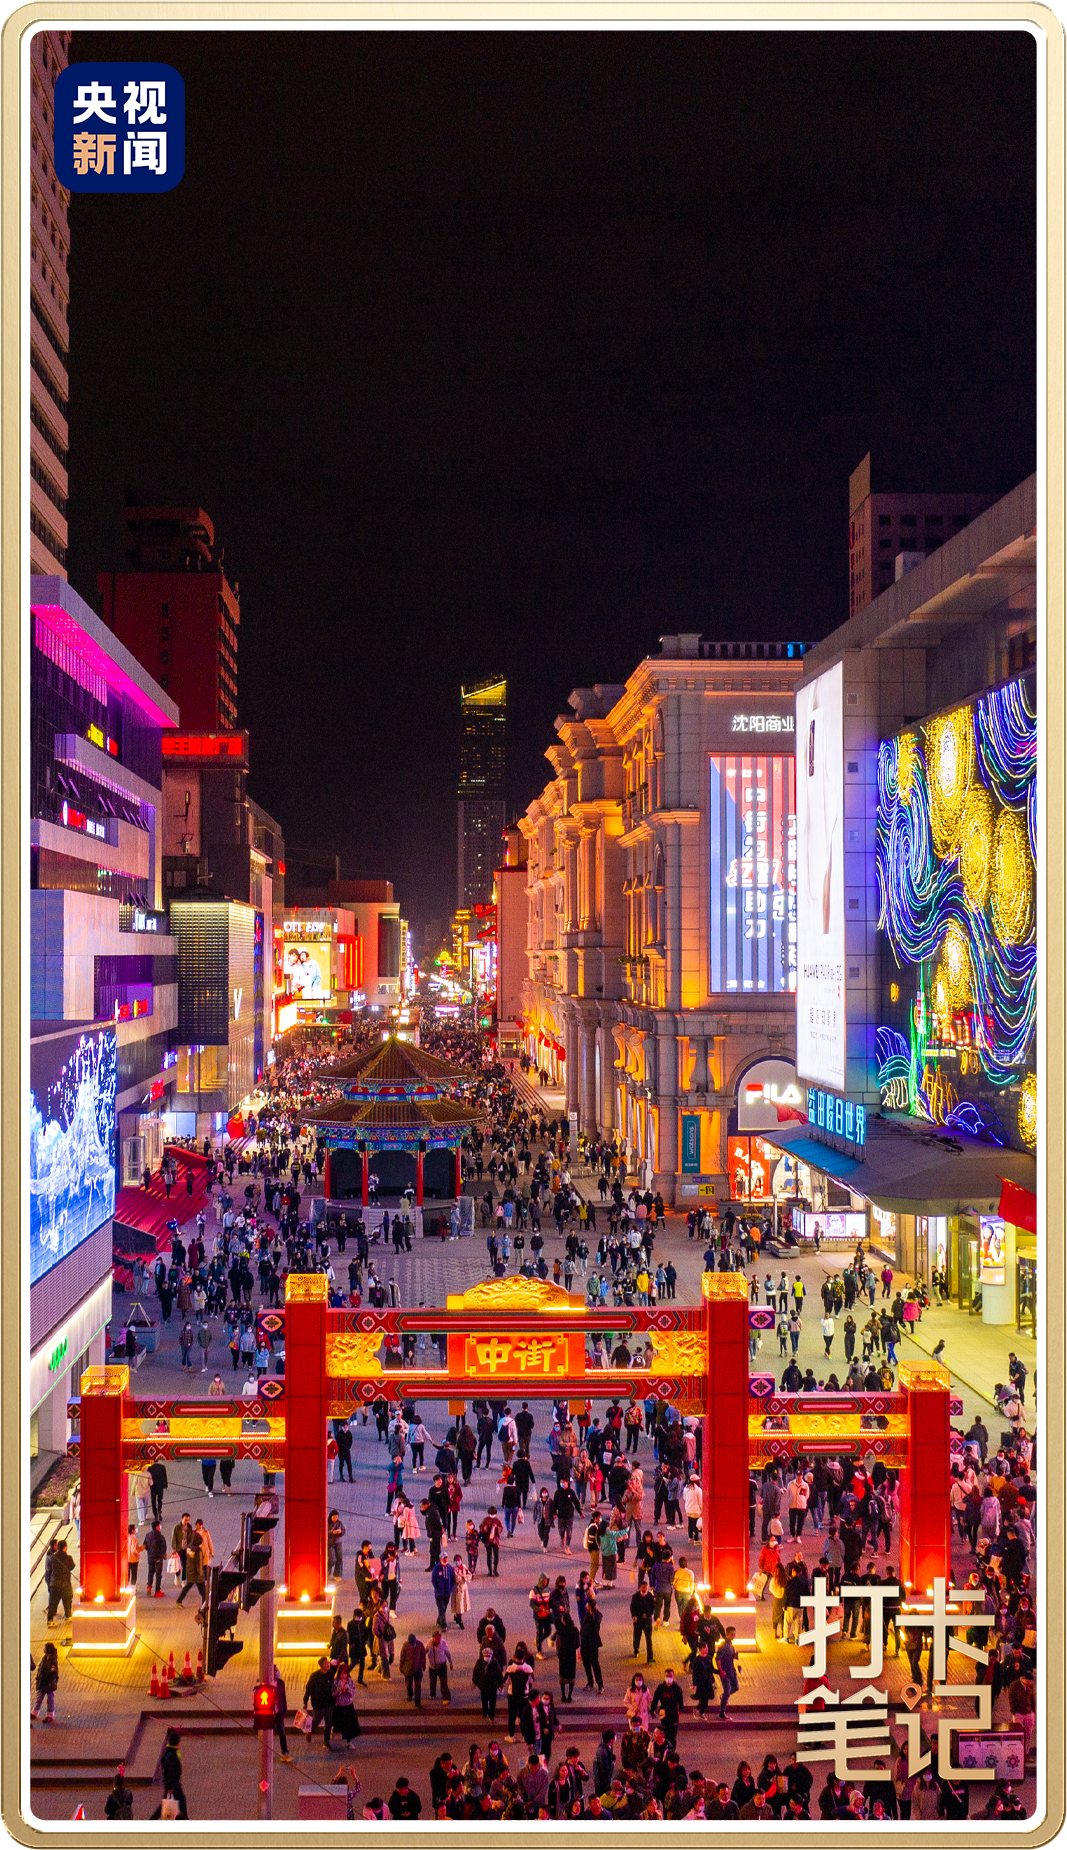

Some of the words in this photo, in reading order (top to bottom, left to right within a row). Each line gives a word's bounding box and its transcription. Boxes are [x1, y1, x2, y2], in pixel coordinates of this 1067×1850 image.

[731, 714, 795, 732] 沈阳商业
[745, 1083, 801, 1104] FILA
[808, 1087, 866, 1146] 益田假日世界
[476, 1338, 557, 1373] 中街
